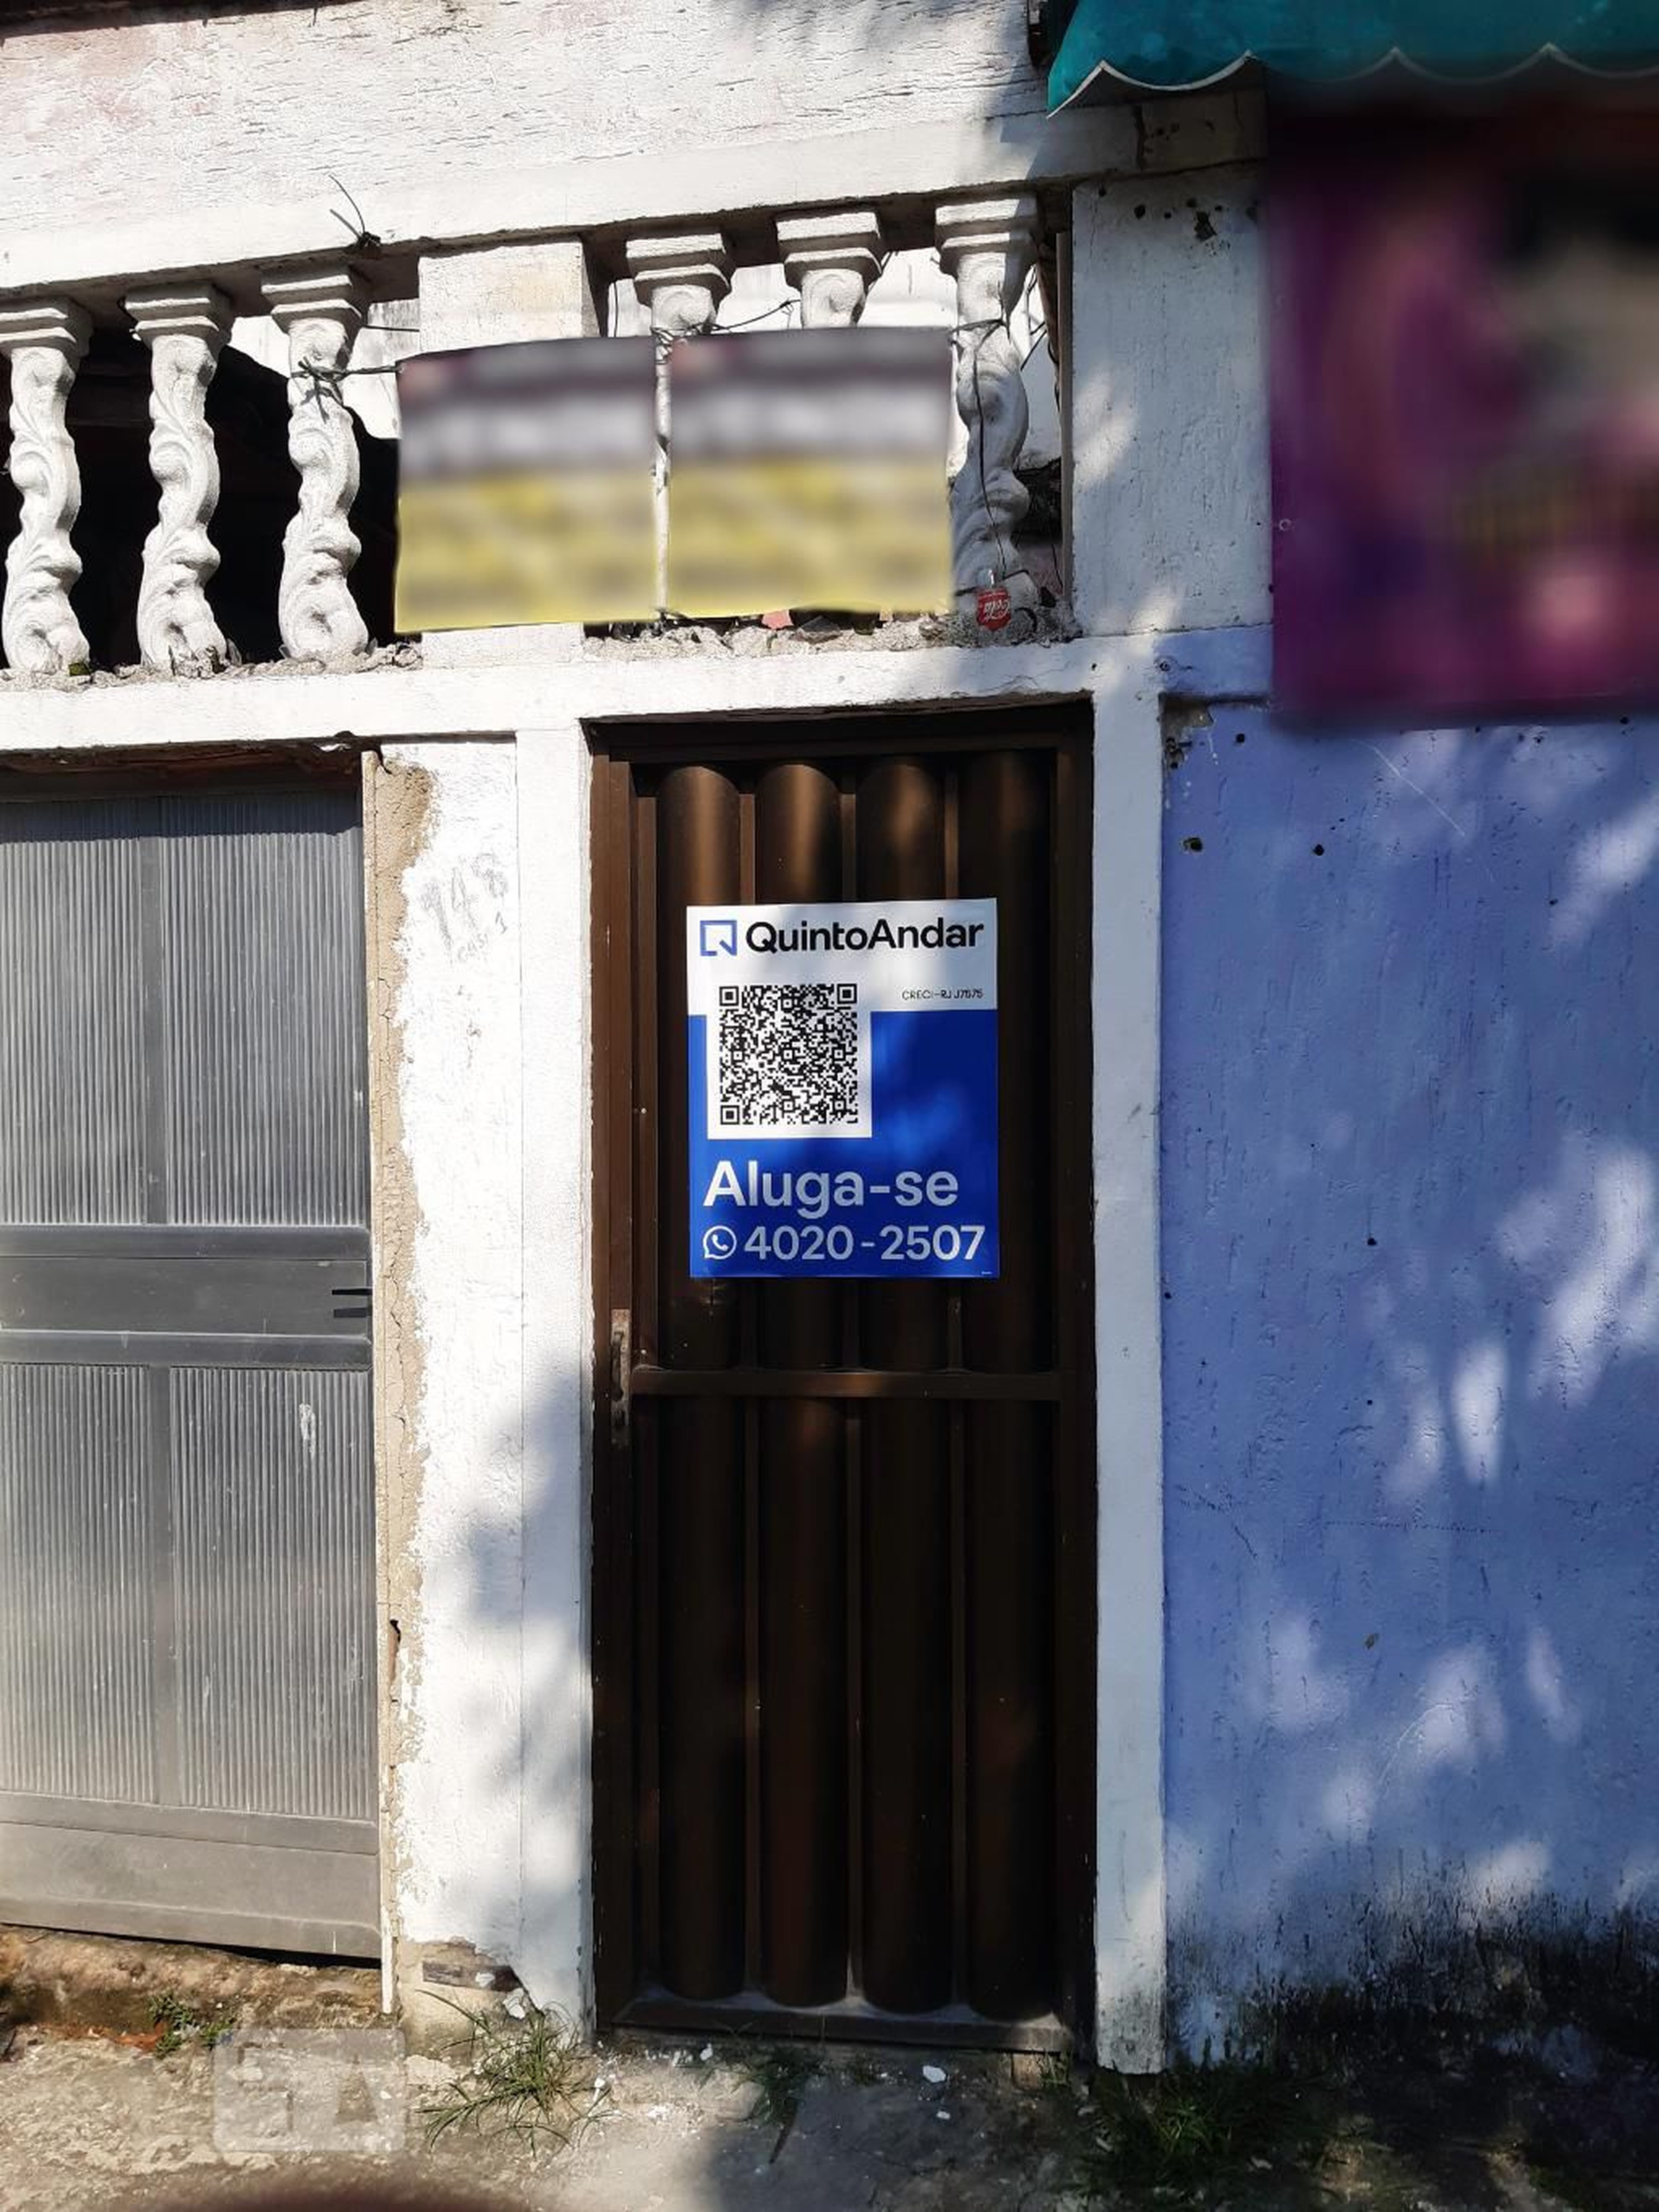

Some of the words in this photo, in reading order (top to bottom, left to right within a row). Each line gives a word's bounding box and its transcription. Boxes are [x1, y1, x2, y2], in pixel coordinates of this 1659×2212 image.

[746, 917, 985, 953] QuintoAndar
[902, 989, 952, 1000] CRECI-RJ
[703, 1160, 958, 1219] Aluga-se
[744, 1225, 985, 1260] 4020-2507
